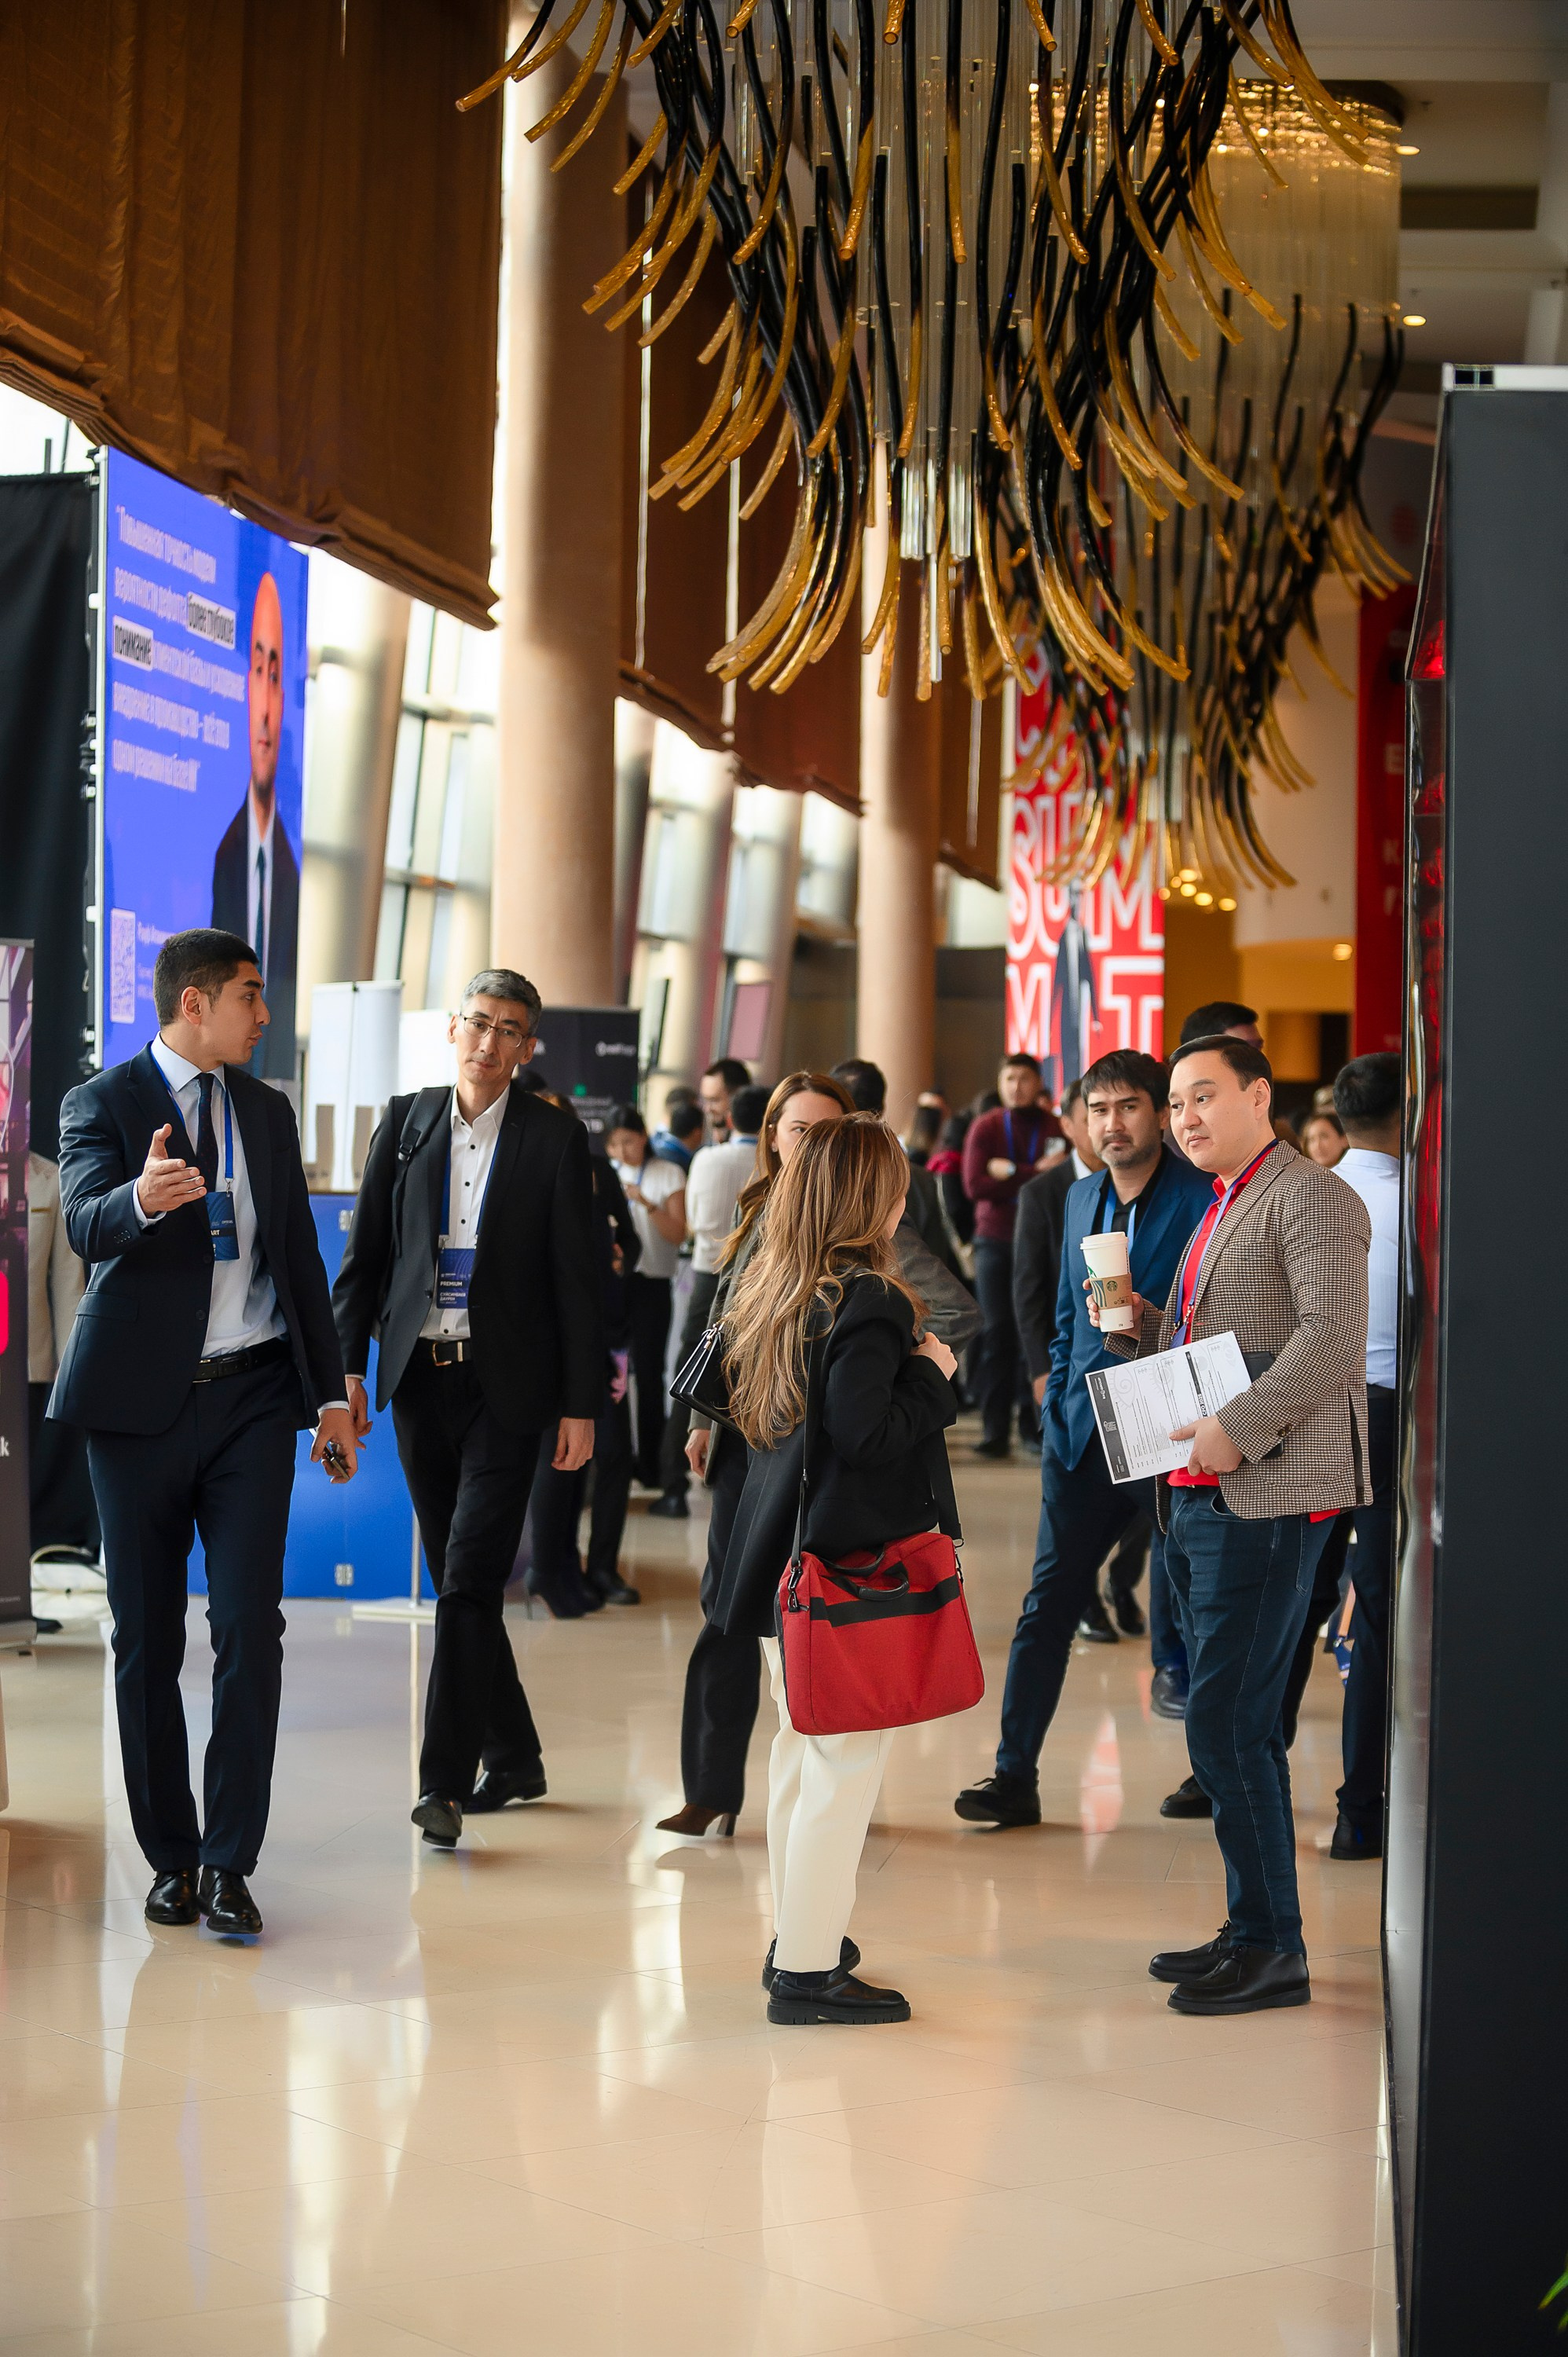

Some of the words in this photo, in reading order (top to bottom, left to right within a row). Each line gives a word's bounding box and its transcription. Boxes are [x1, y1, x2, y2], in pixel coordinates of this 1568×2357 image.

[189, 595, 207, 632] более
[207, 607, 233, 644] глубокое
[115, 625, 151, 665] понимание
